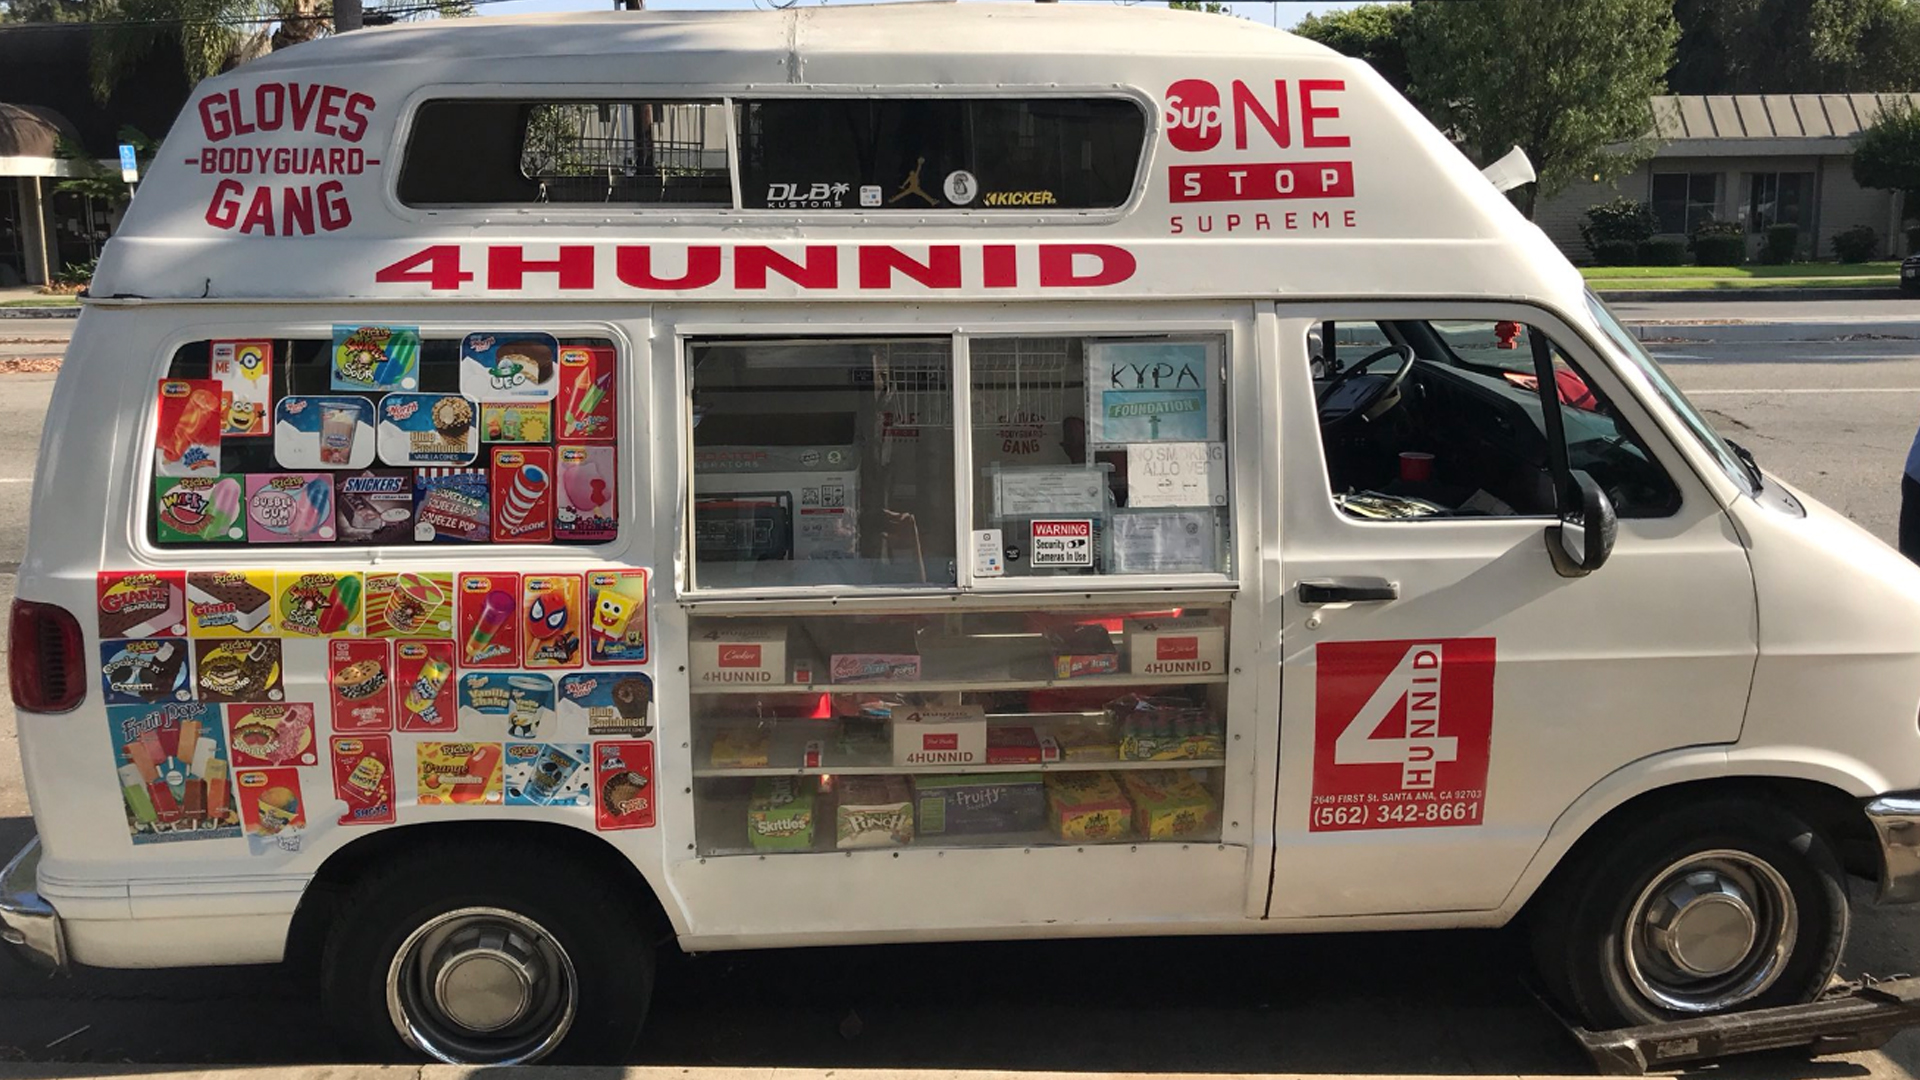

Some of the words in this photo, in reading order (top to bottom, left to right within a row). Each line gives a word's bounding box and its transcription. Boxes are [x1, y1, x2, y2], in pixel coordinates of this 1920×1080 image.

[198, 82, 376, 143] GLOVES
[1184, 169, 1339, 197] STOP
[767, 183, 831, 201] DLB
[205, 178, 352, 237] GANG
[1170, 210, 1356, 233] SUPREME
[375, 244, 1137, 290] 4HUNNID
[215, 362, 230, 374] ME
[1111, 363, 1200, 389] KYPA
[490, 374, 526, 390] UFO
[1114, 400, 1194, 417] FOUNDATION
[1002, 440, 1041, 454] GANG
[1143, 461, 1212, 477] ALLOED
[345, 478, 401, 491] SNICKERS
[163, 492, 209, 514] WACKY
[253, 495, 293, 507] BUBBLE
[262, 508, 290, 519] GUM
[420, 510, 457, 529] SQUEEZE
[458, 521, 476, 532] POP
[1035, 524, 1087, 535] WARNING
[1036, 539, 1065, 550] Security
[1036, 552, 1064, 561] Cameras
[1067, 552, 1073, 561] In
[1075, 552, 1087, 561] Use
[103, 657, 151, 674] Cookies
[1144, 661, 1212, 675] 4HUNNID
[702, 671, 772, 683] 4HUNNID
[468, 688, 510, 699] Vanilla
[471, 698, 509, 707] Shake
[1334, 643, 1459, 791] 4
[1406, 650, 1439, 785] HUNNID
[906, 752, 974, 764] 4HUNNID
[956, 787, 1000, 805] Fruity
[1338, 794, 1364, 804] FIRST
[1382, 792, 1413, 802] SANTA
[1439, 791, 1453, 800] CA
[1454, 790, 1482, 800] 92703
[354, 804, 388, 818] SHOTS
[1314, 805, 1369, 828] (562)
[1376, 802, 1479, 824] 342-8661
[757, 817, 807, 834] Skittles
[850, 814, 907, 833] PUNCH
